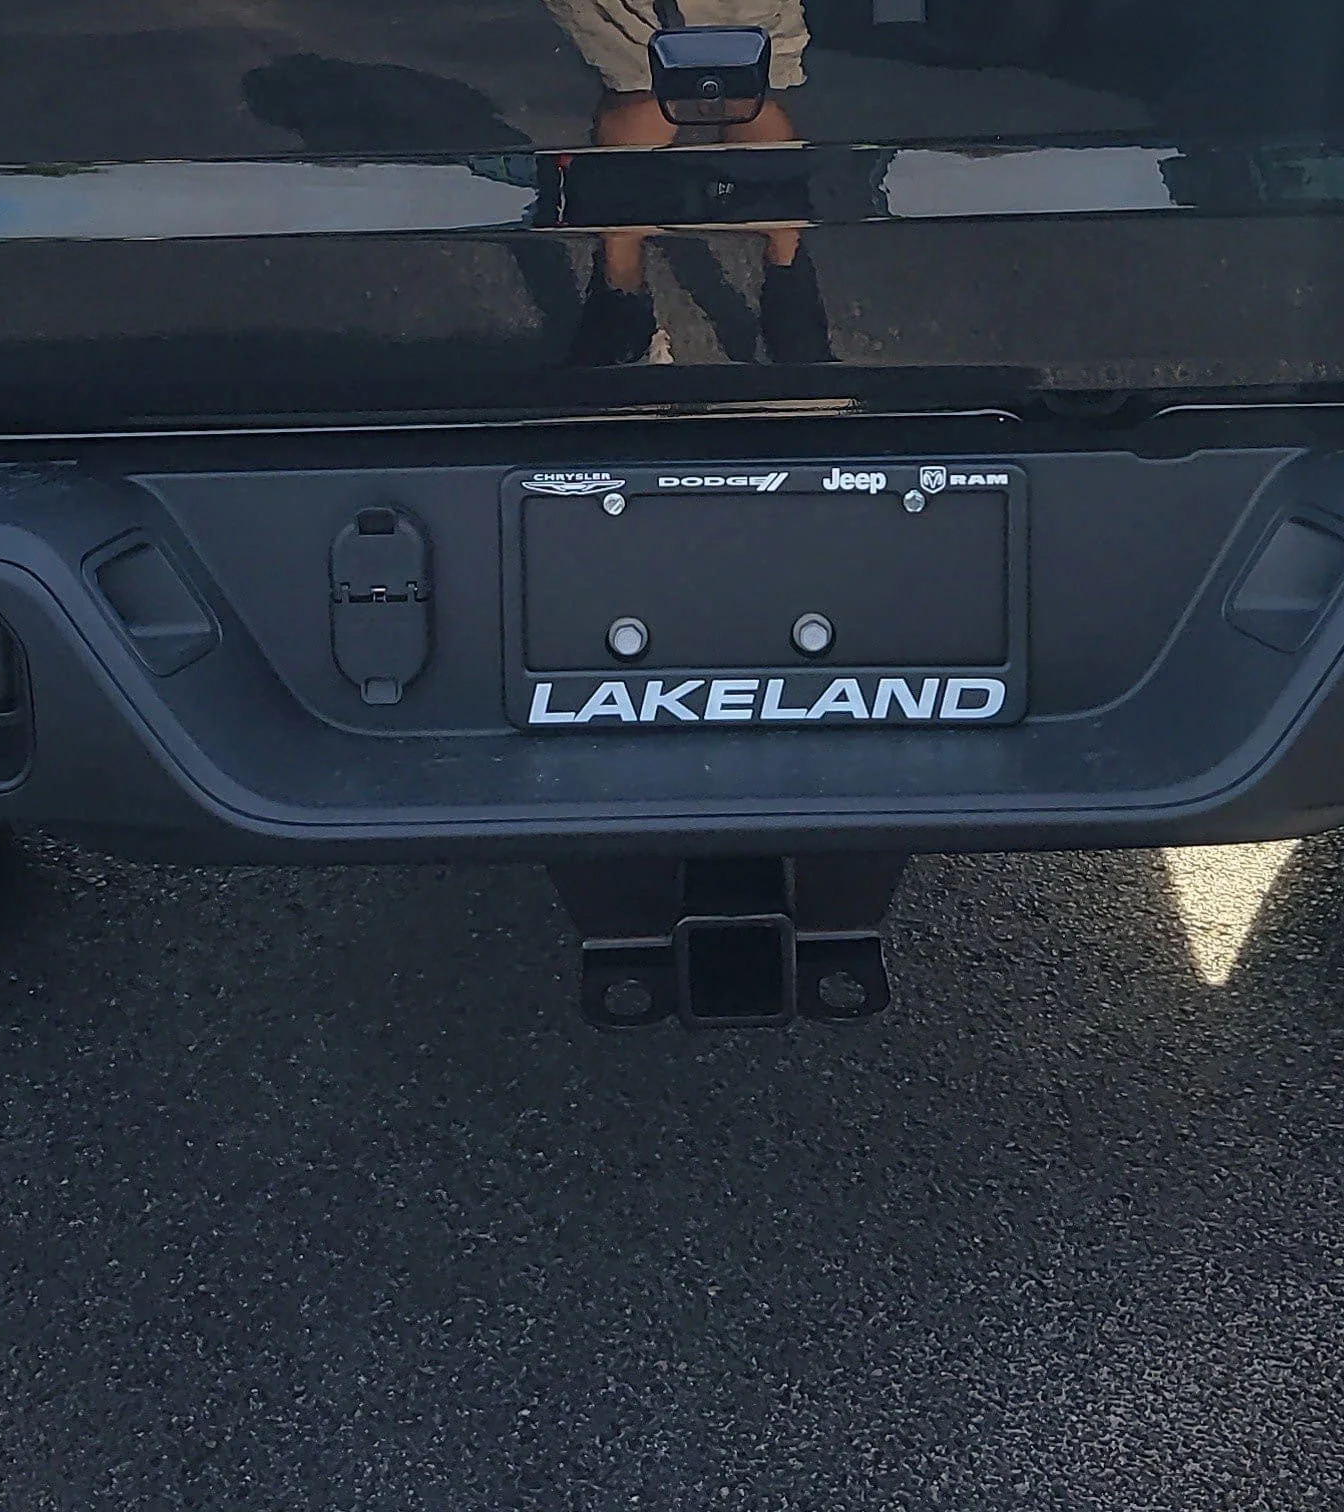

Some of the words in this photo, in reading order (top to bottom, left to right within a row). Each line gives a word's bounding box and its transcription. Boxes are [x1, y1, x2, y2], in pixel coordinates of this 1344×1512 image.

[533, 473, 611, 482] CHRYSLER
[658, 475, 769, 488] DODGE
[822, 467, 887, 494] Jeep
[950, 474, 1009, 486] RAM
[528, 677, 1007, 724] LAKELAND
